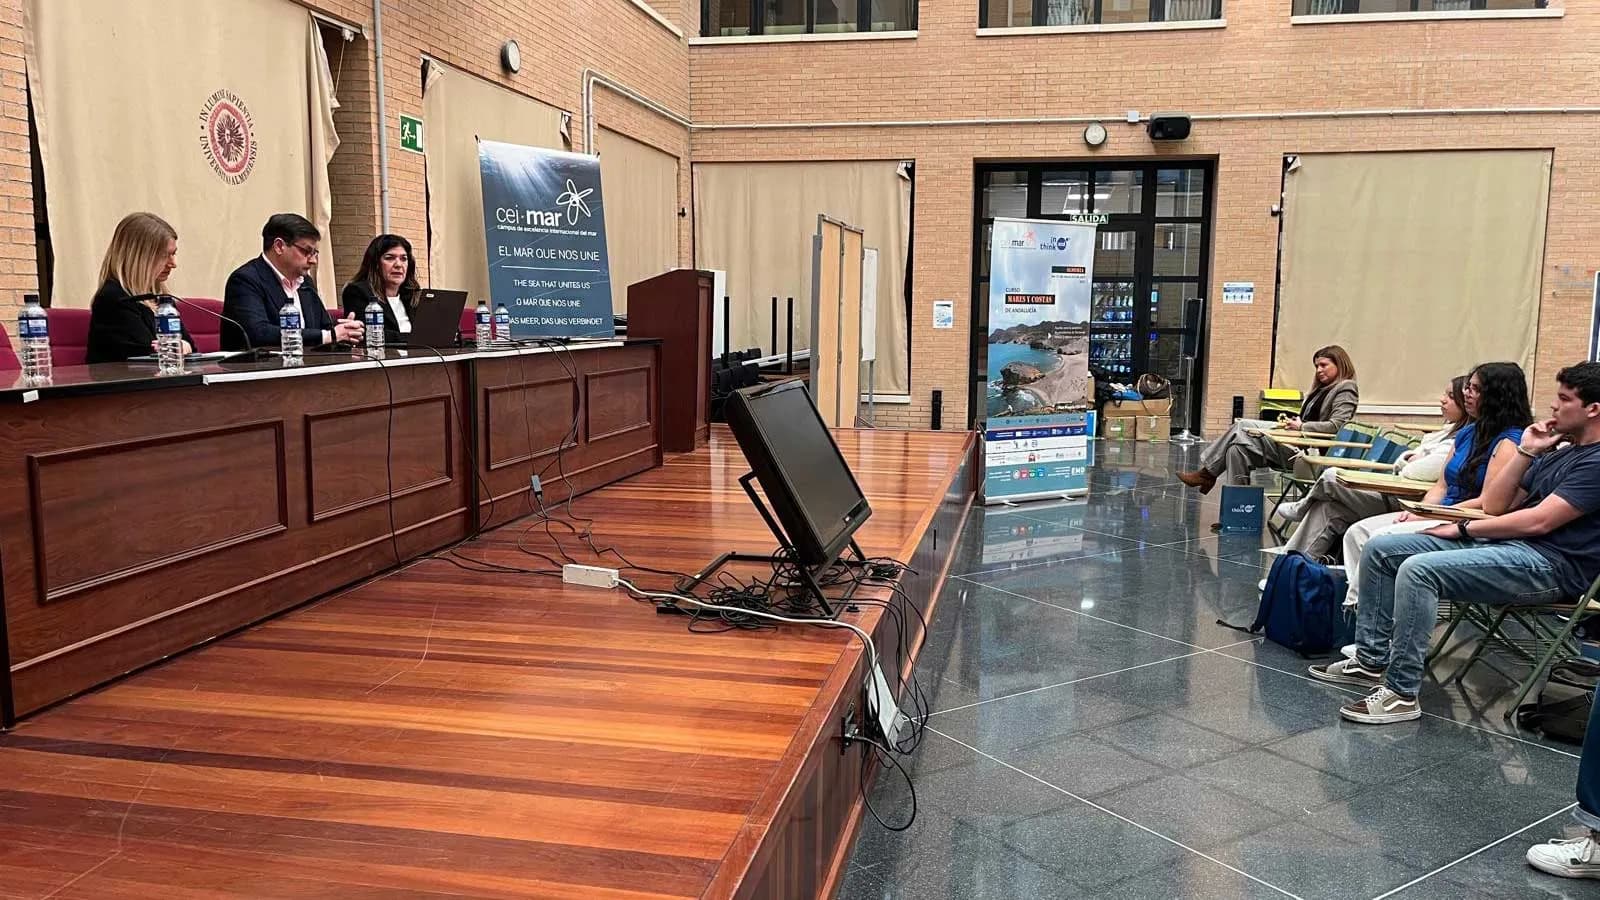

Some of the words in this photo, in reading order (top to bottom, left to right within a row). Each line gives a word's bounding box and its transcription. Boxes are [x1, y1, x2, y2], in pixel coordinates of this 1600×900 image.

[1072, 214, 1107, 223] SALIDA
[1040, 242, 1056, 250] think
[498, 245, 511, 257] EL
[513, 246, 534, 258] MAR
[535, 248, 557, 259] QUE
[558, 250, 578, 260] NOS
[580, 251, 600, 261] UNE
[514, 279, 528, 287] THE
[528, 280, 540, 288] SEA
[541, 280, 557, 288] THAT
[558, 281, 580, 289] UNITES
[516, 298, 521, 306] O
[523, 298, 538, 306] MAR
[538, 298, 551, 307] QUE
[552, 299, 567, 307] NOS
[1007, 295, 1026, 303] MARES
[1031, 295, 1052, 303] COSTAS
[509, 317, 520, 325] AS
[520, 317, 540, 326] MEER,
[541, 317, 555, 325] DAS
[567, 318, 603, 326] VERBINDET
